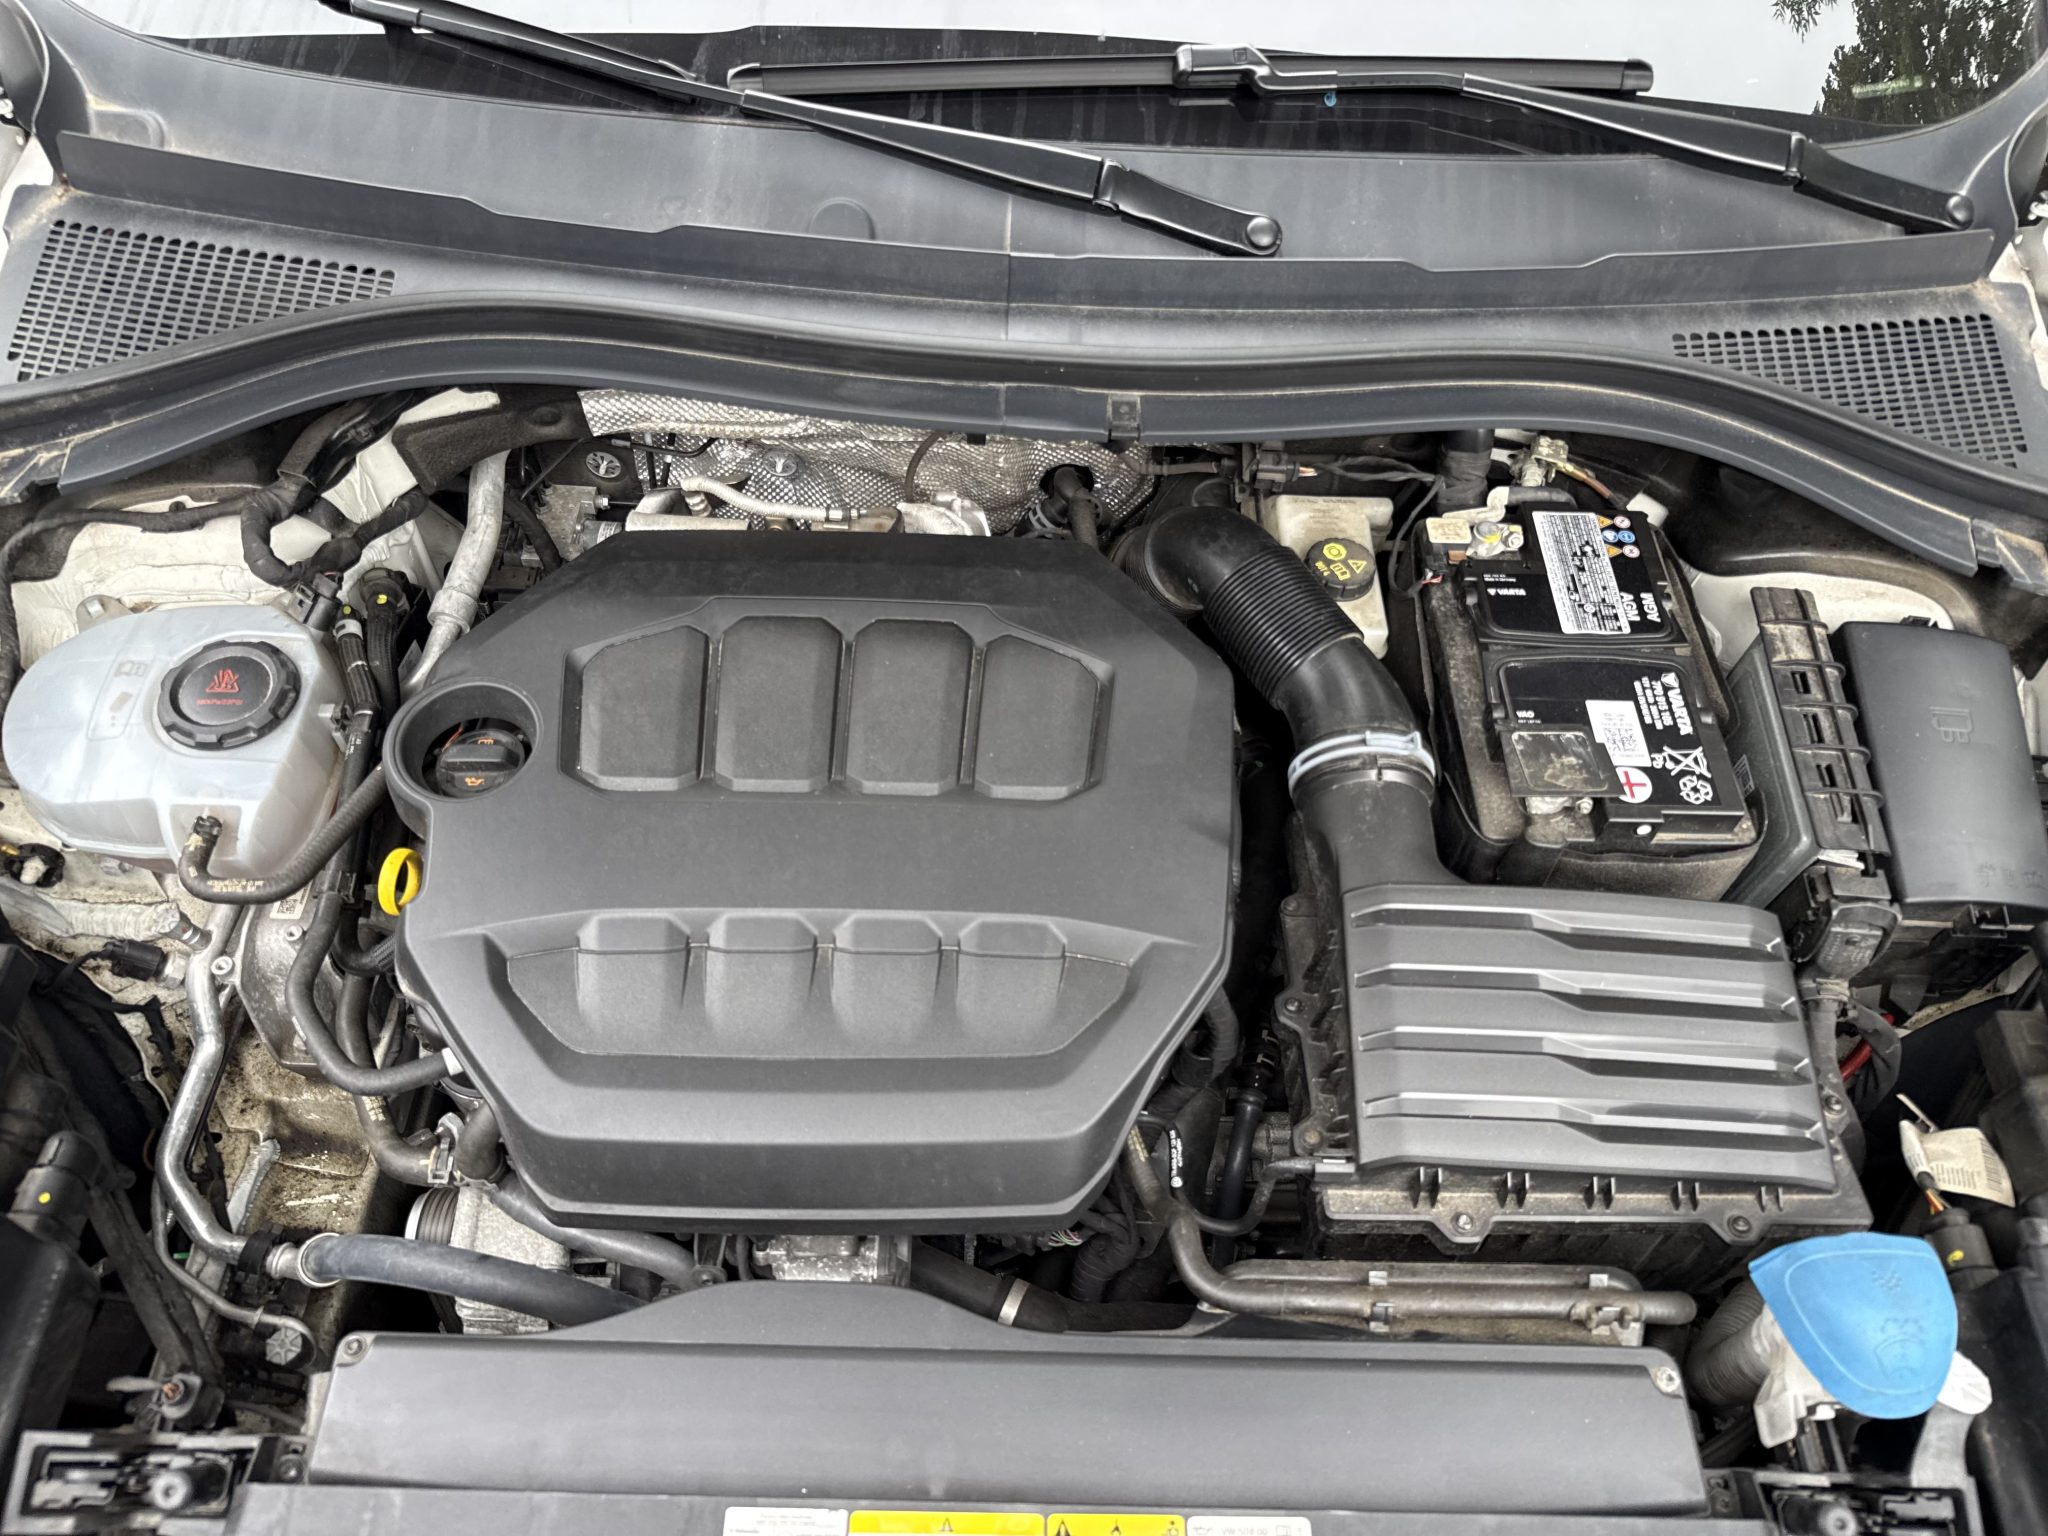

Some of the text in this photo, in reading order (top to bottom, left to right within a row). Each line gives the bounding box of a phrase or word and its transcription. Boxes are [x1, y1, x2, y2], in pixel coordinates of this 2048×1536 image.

[1496, 587, 1527, 596] VARTA
[1620, 591, 1641, 621] AGM
[1640, 592, 1661, 622] AGM
[1667, 688, 1693, 736] VARTA
